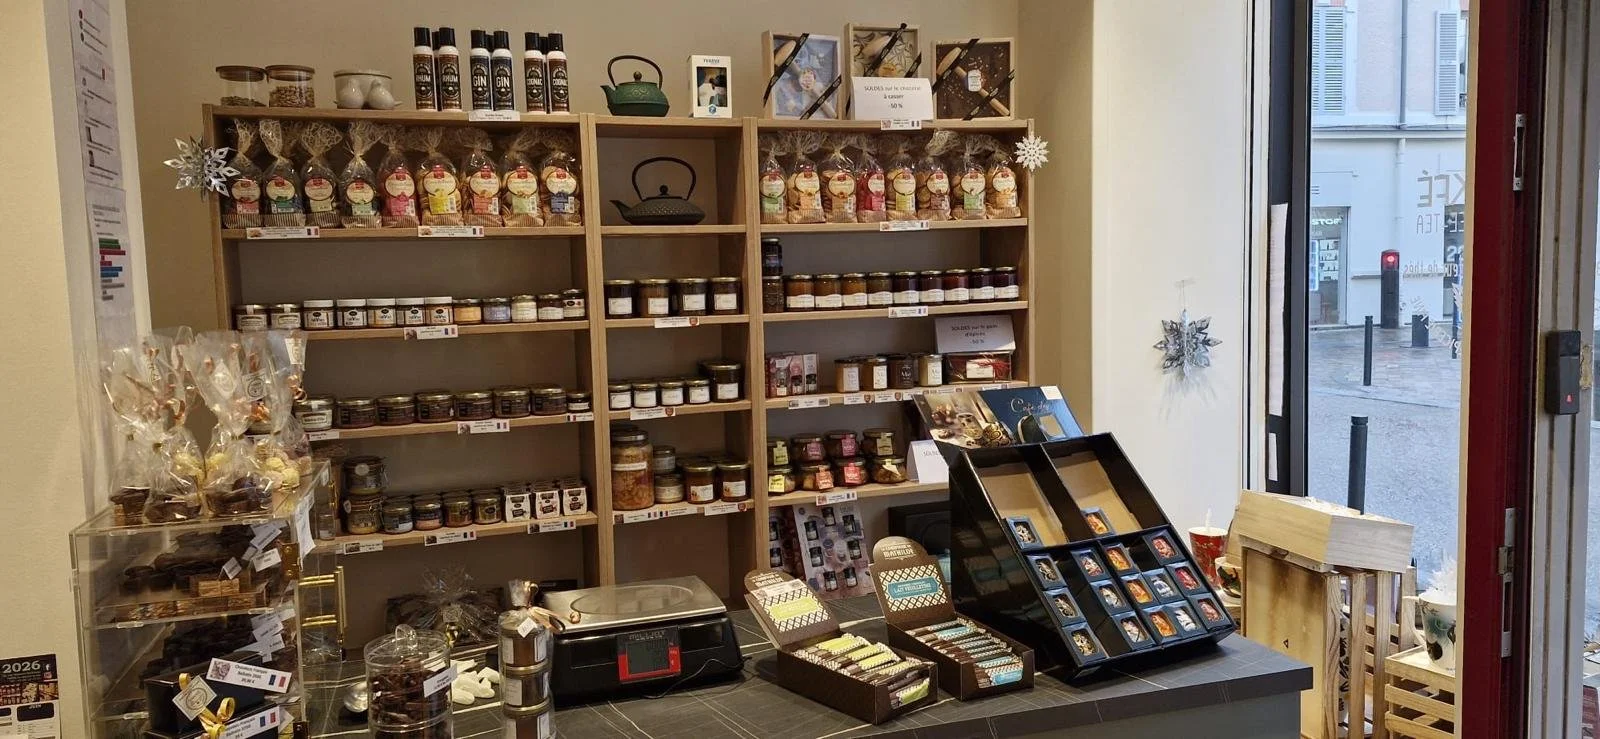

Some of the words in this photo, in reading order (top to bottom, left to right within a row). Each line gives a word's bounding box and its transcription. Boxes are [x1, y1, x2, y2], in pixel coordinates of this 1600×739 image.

[415, 75, 431, 83] RHUM
[442, 75, 458, 83] RHUM
[472, 75, 487, 87] GIN
[495, 76, 510, 87] GIN
[526, 78, 543, 86] COGNAC
[552, 78, 568, 86] COGNAC
[883, 548, 914, 558] MATHILDE
[755, 577, 784, 587] MATHILDE
[2, 660, 41, 674] 2026
